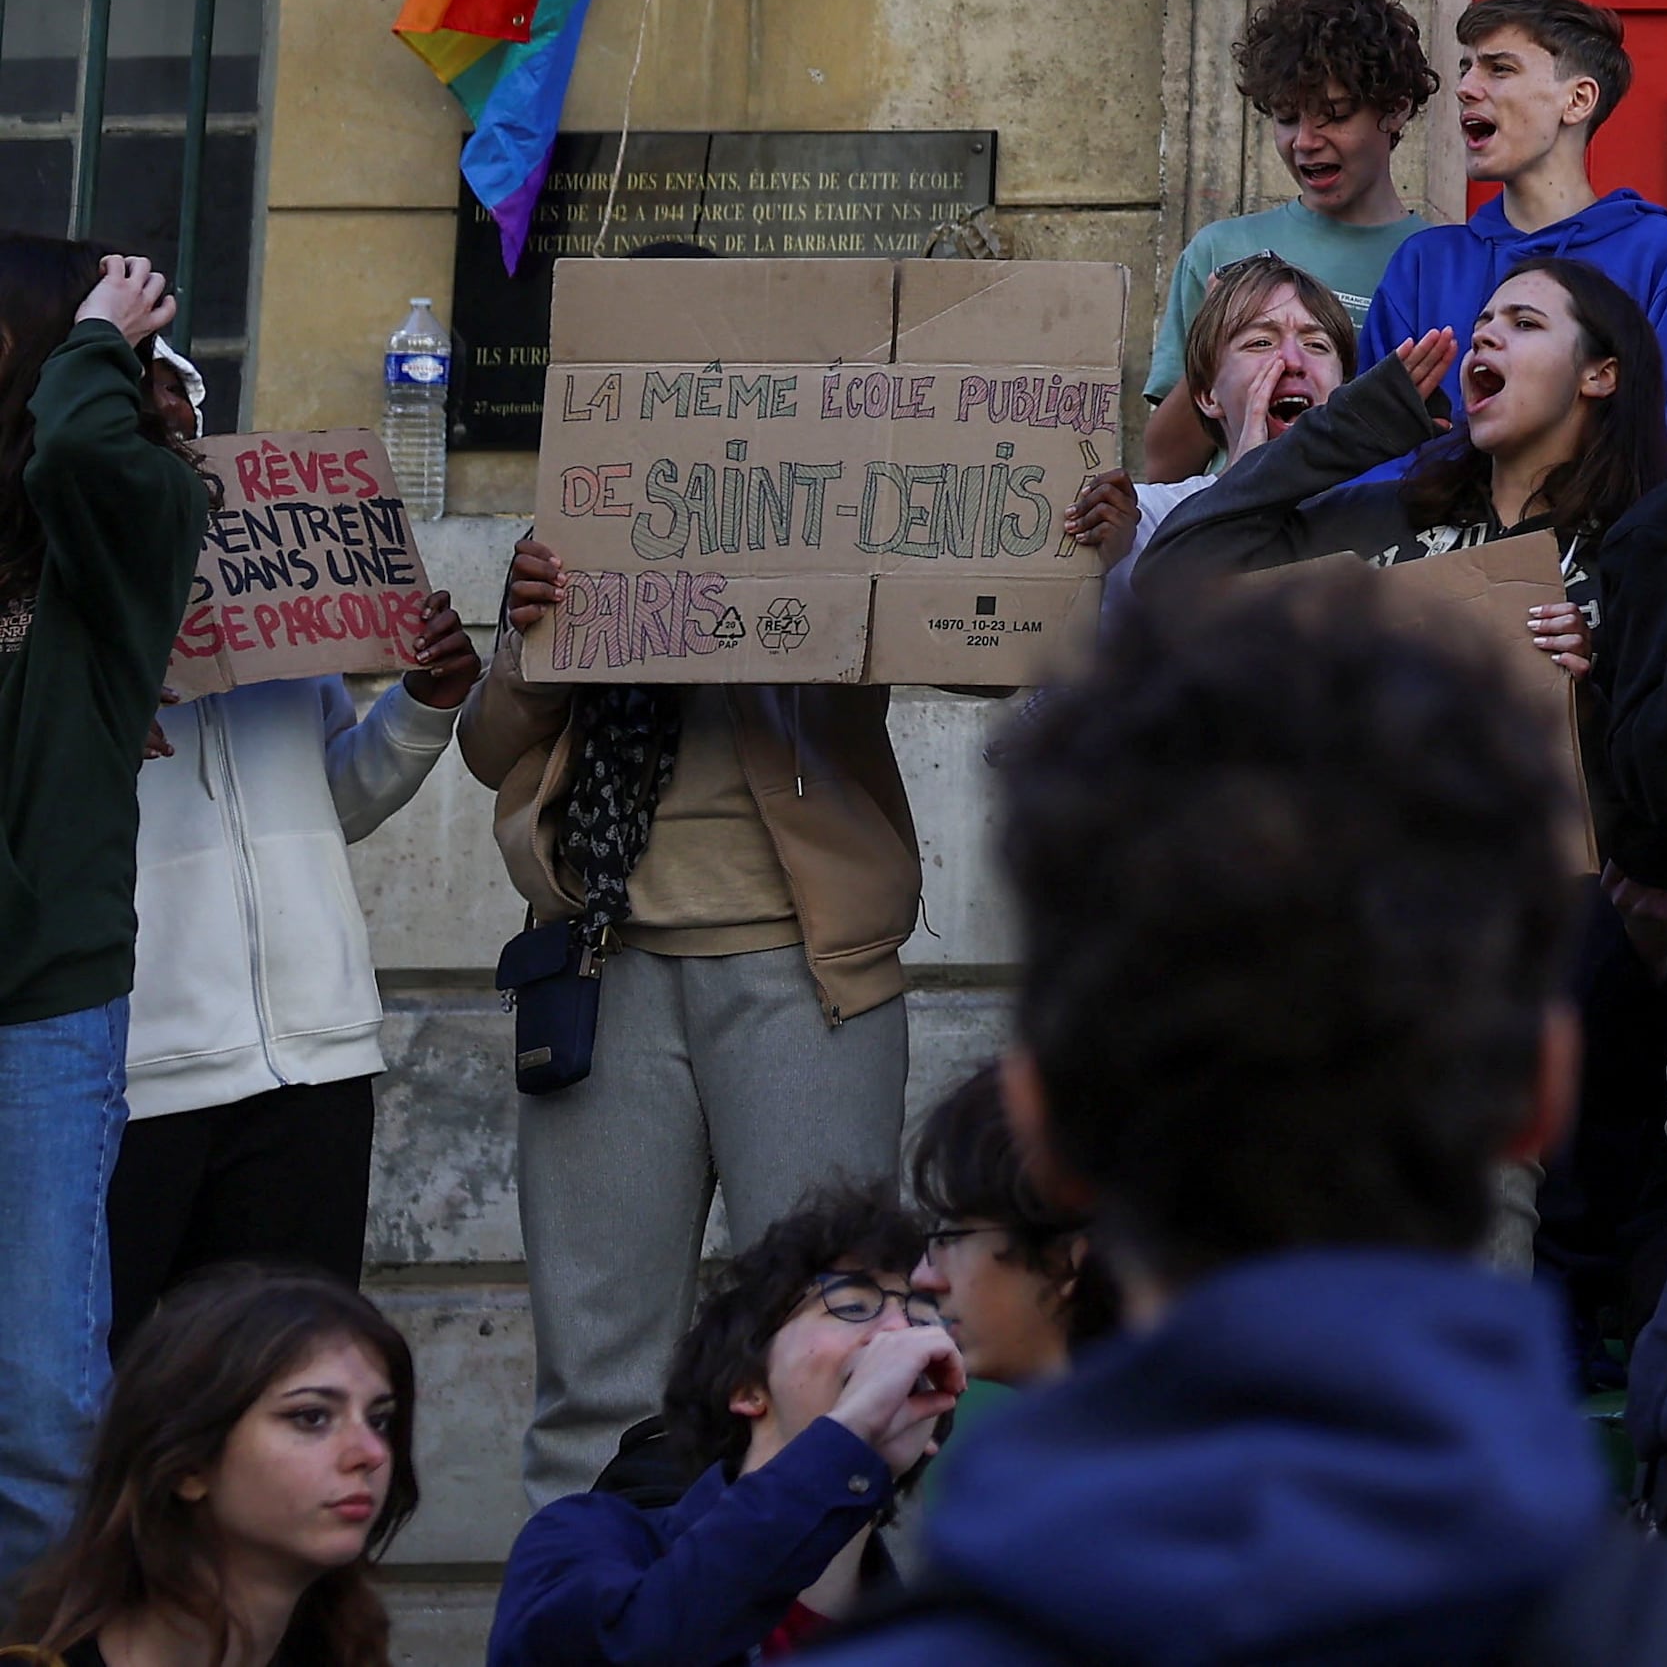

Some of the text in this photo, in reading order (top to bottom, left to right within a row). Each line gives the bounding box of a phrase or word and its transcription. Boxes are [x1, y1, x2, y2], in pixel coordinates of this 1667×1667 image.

[627, 172, 656, 190] DES
[819, 172, 840, 190] DE
[849, 172, 900, 190] CETTE
[910, 168, 964, 190] ÉCOLE
[567, 204, 589, 221] DE
[598, 204, 628, 221] 142
[654, 204, 684, 221] 1944
[693, 204, 744, 221] PARCE
[753, 203, 806, 224] QU'ILS
[725, 234, 746, 251] DE
[754, 234, 775, 251] LA
[783, 234, 865, 251] BARBARIE
[476, 347, 549, 365] ILS FURE
[563, 373, 621, 421] LA
[640, 358, 798, 420] MÊME
[821, 357, 936, 420] ÉCOLE
[473, 400, 543, 417] 27 septemb
[236, 440, 379, 502] RÊVES
[560, 463, 632, 516] DE
[218, 548, 319, 596] DANS
[326, 547, 415, 587] UNE
[551, 570, 728, 670] PARIS
[928, 619, 1042, 633] 14970_10-23_LAM
[718, 640, 738, 649] PAP
[967, 636, 999, 647] 220N
